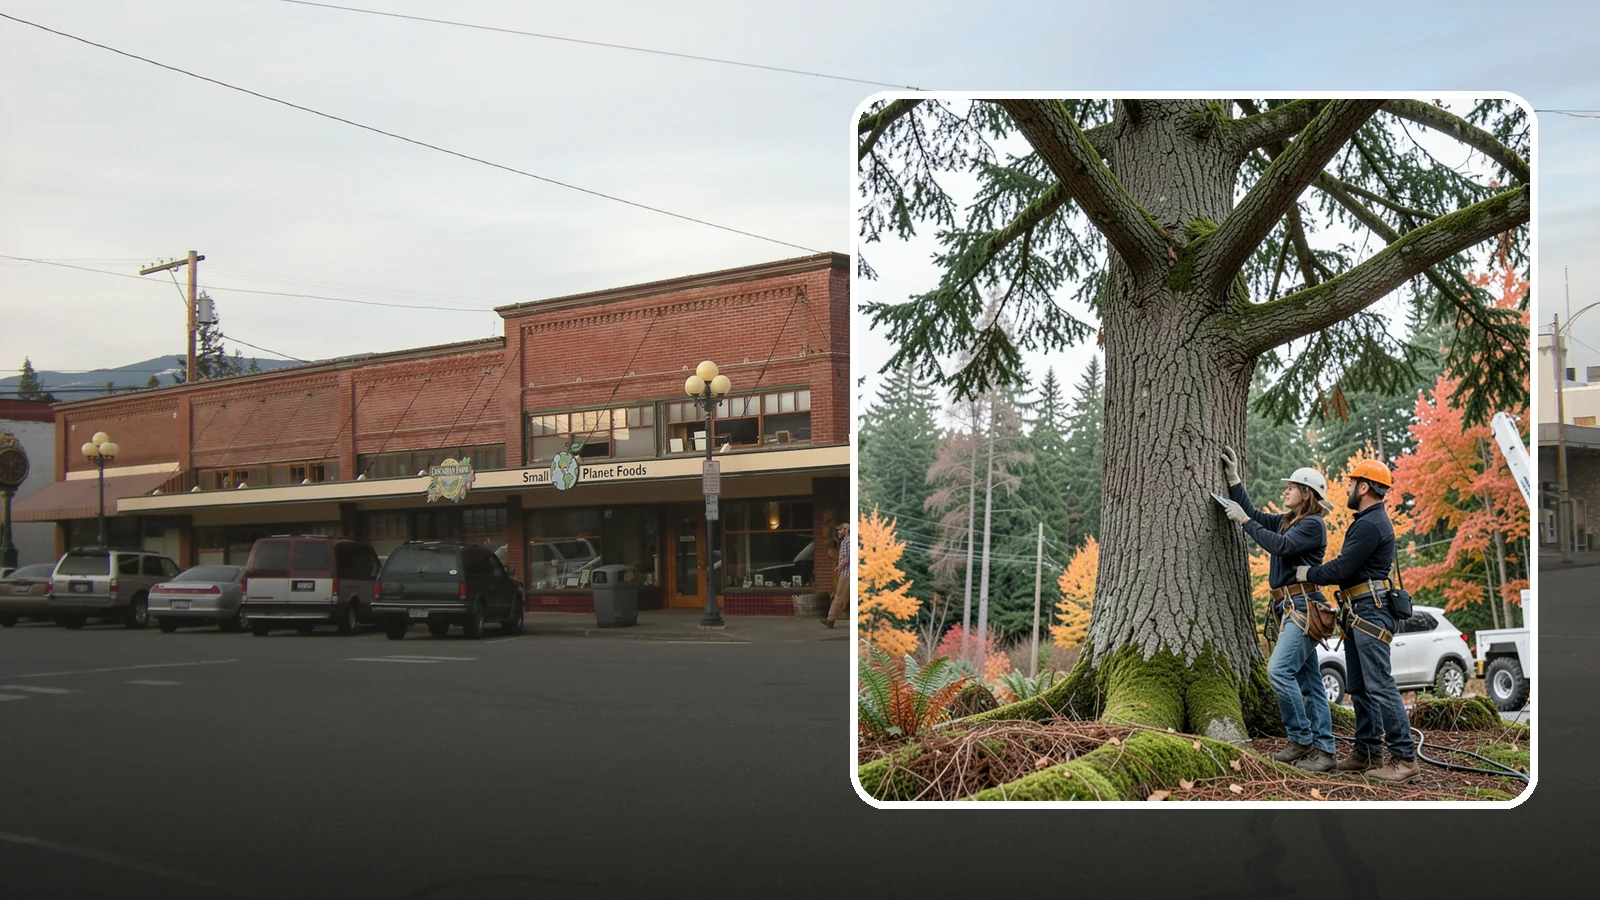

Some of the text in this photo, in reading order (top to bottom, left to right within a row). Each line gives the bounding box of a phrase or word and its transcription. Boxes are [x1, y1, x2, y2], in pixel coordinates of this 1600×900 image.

[523, 464, 647, 483] Small Planet Foods
